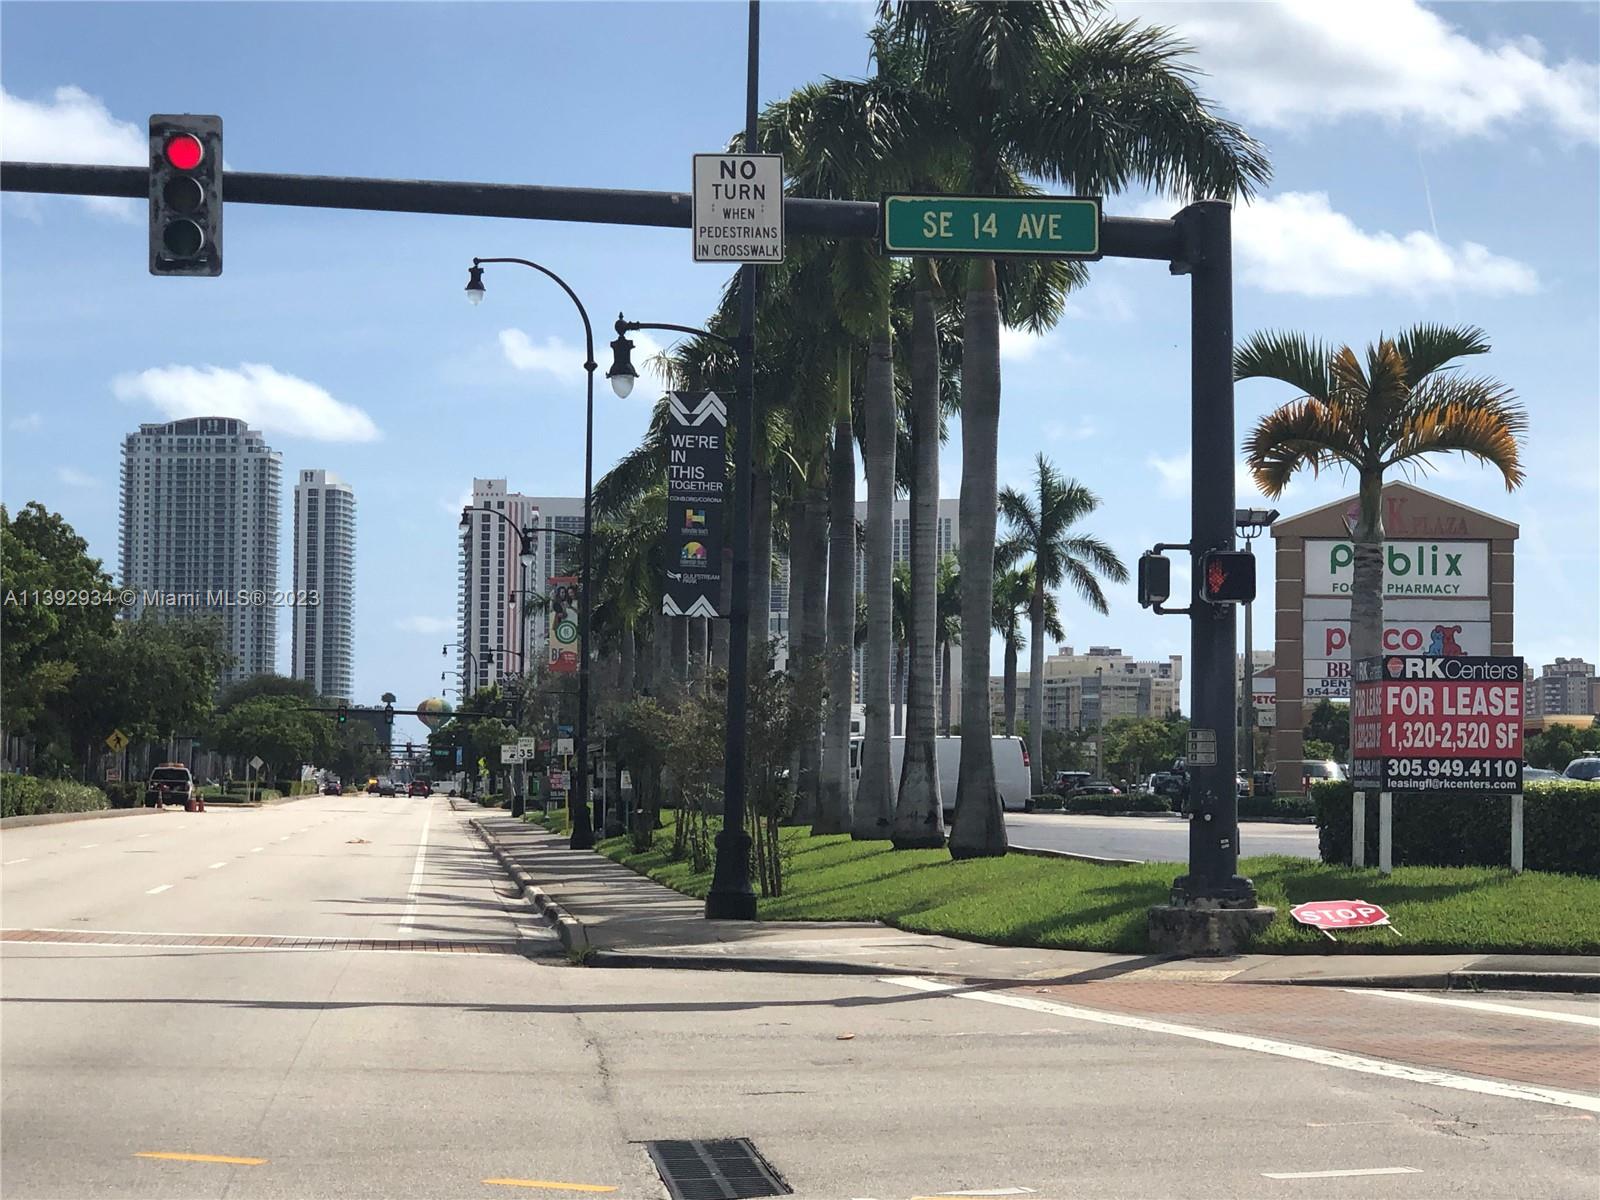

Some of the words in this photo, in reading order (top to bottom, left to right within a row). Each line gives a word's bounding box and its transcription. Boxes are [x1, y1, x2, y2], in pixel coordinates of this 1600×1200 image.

[720, 160, 756, 180] NO
[712, 183, 765, 200] TURN
[723, 208, 755, 220] WHEN
[699, 226, 778, 239] PEDESTRIANS
[922, 211, 953, 238] SE
[972, 213, 998, 239] 14
[1017, 214, 1062, 240] AVE
[698, 244, 709, 257] IN
[713, 244, 779, 257] CROSSWALK
[671, 434, 719, 449] WE'RE
[671, 450, 686, 463] IN
[670, 465, 705, 480] THIS
[670, 480, 723, 491] TOGETHER
[1330, 544, 1462, 577] pblix
[1387, 583, 1460, 594] PHARMACY
[1325, 626, 1423, 657] pco
[1387, 686, 1435, 716] FOR
[1442, 686, 1519, 716] LEASE
[1388, 721, 1490, 752] 1,320-2,520
[1495, 722, 1519, 749] SF
[519, 749, 533, 758] 35
[1388, 759, 1517, 778] 305.949.4110
[1387, 778, 1517, 790] leasingfl@rkcenters.com
[1300, 907, 1376, 923] STOP
